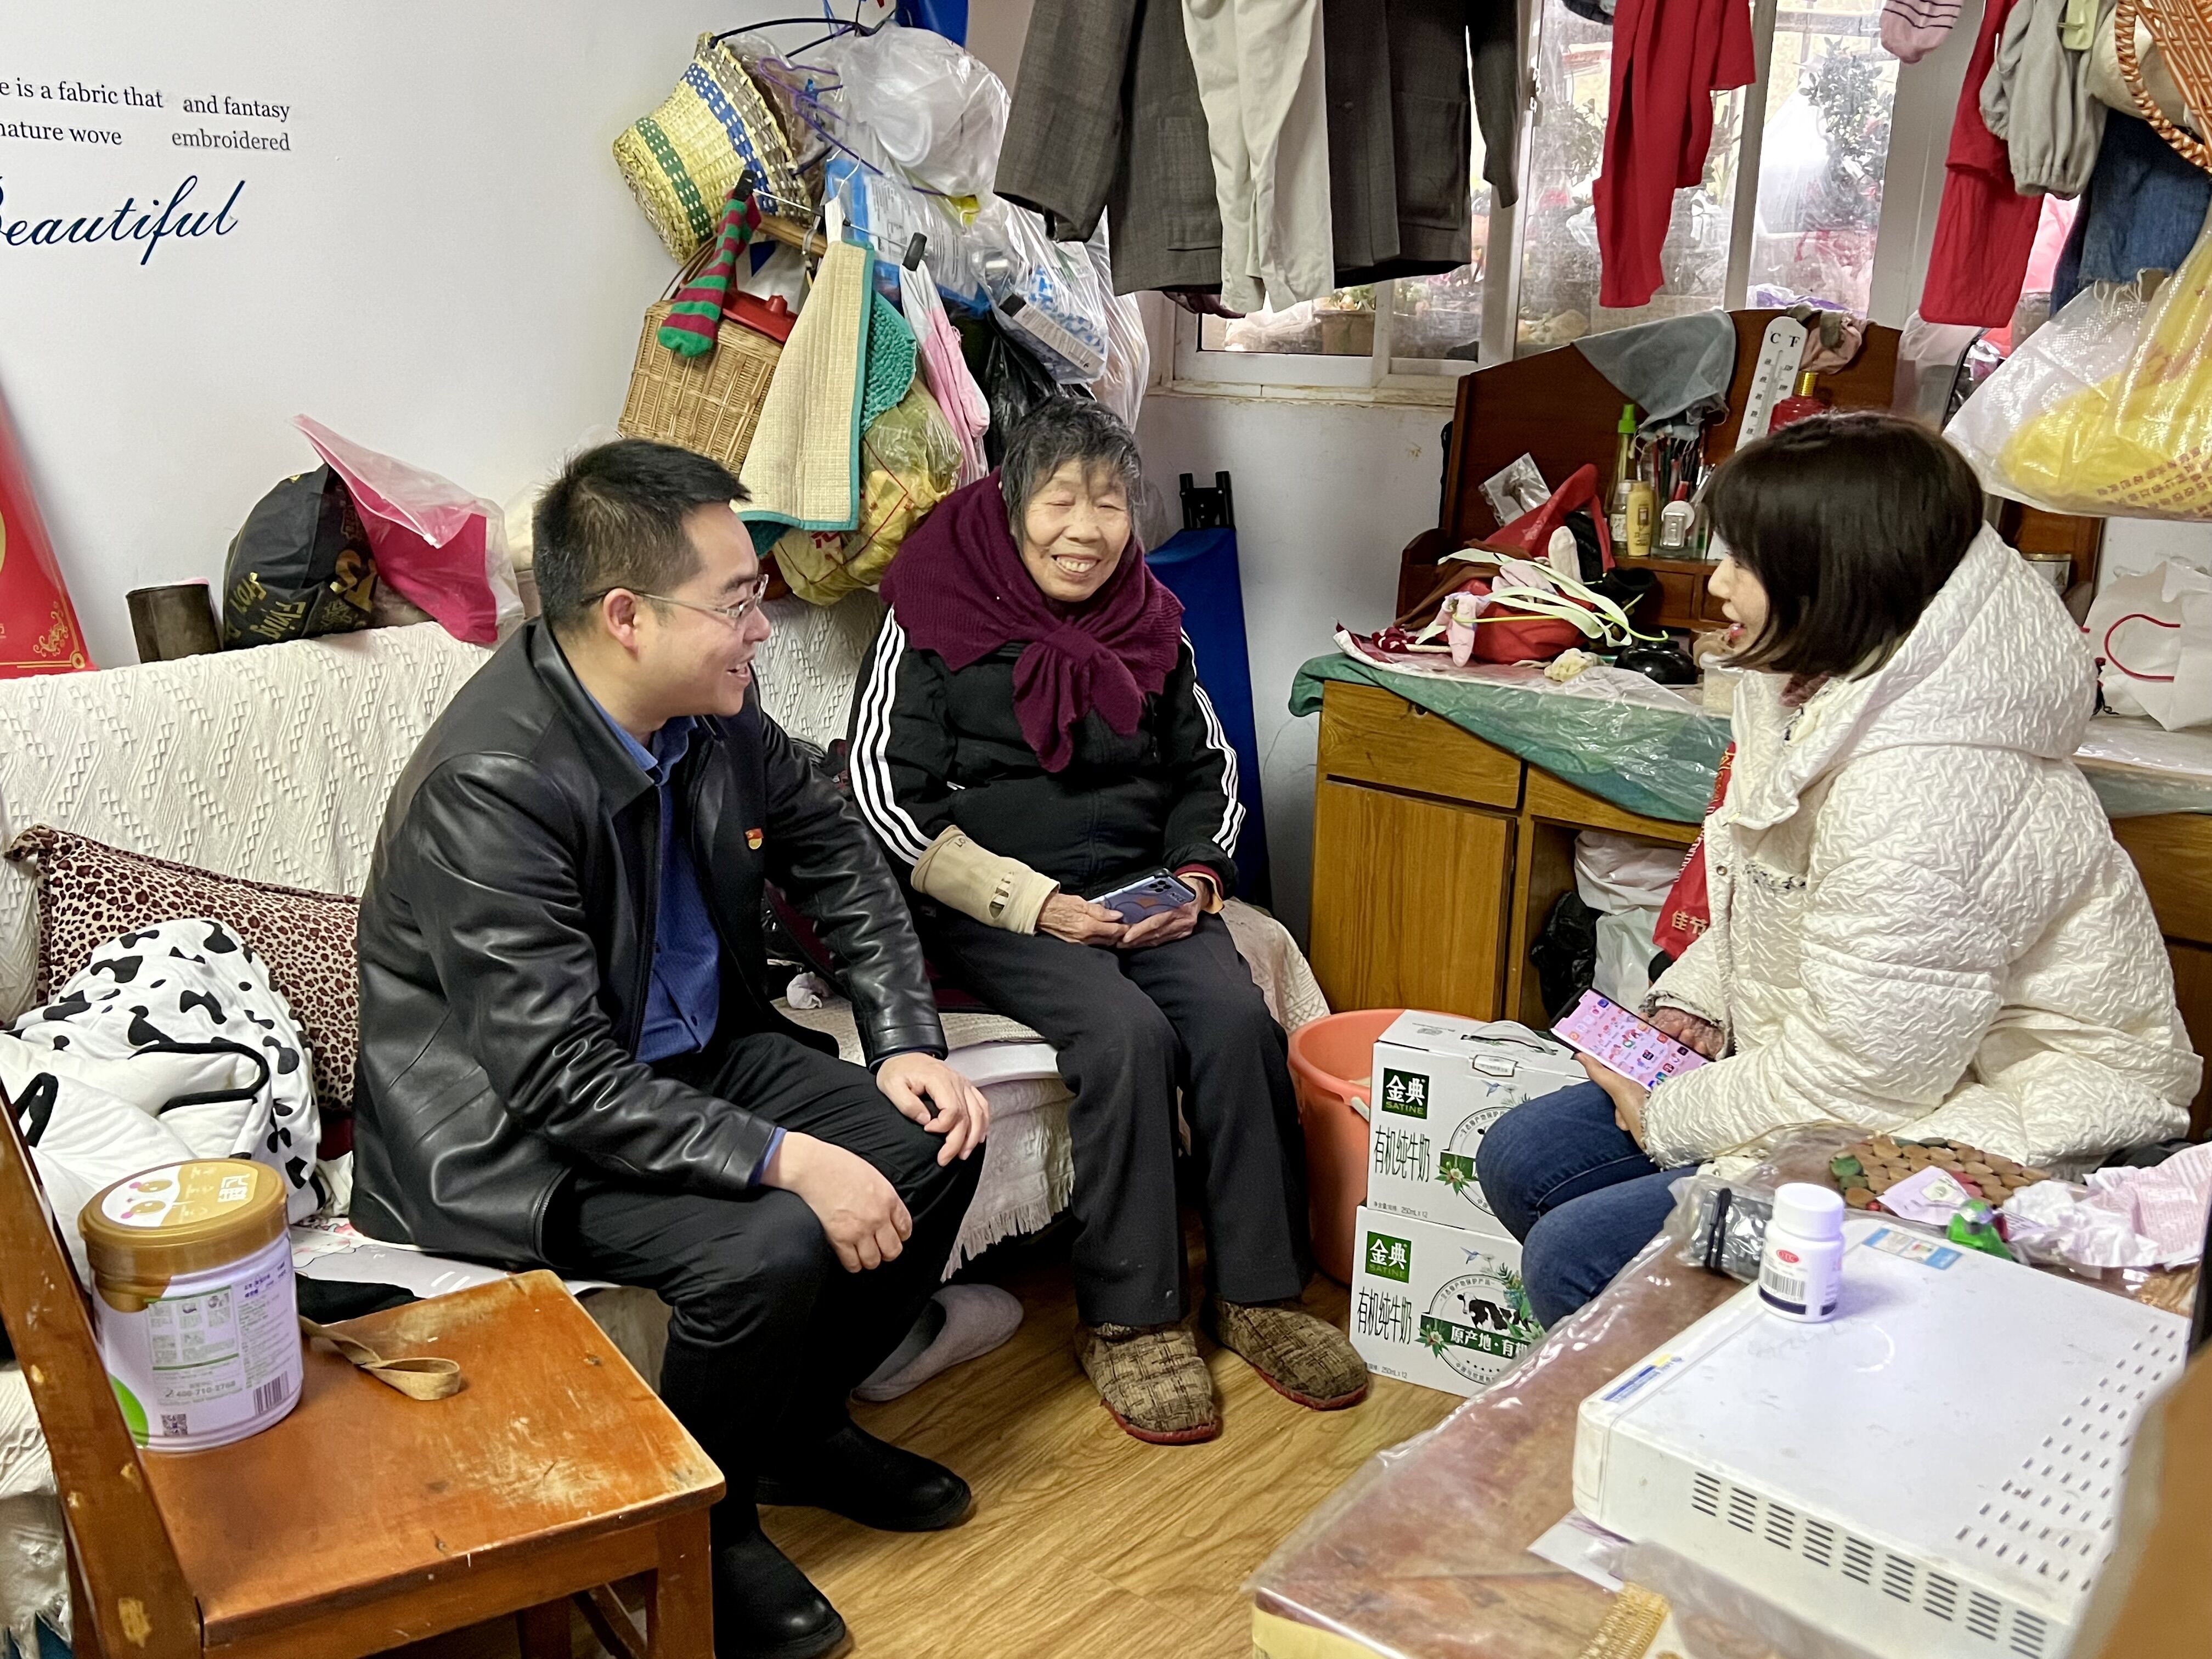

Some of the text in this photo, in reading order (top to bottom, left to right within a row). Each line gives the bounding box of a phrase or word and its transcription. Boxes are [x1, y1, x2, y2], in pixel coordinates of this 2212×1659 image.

[16, 77, 33, 97] is
[41, 85, 53, 99] a
[58, 81, 119, 104] fabric
[124, 86, 163, 108] that
[183, 95, 290, 122] and fantasy
[69, 127, 122, 145] wove
[172, 128, 291, 151] embroidered
[0, 175, 246, 266] eautiful
[1386, 1074, 1425, 1106] 金典
[1385, 1101, 1424, 1115] SATINE
[1374, 1125, 1430, 1182] 有机纯牛奶
[1369, 1238, 1407, 1270] 金典
[1369, 1263, 1406, 1279] SATINE
[1357, 1286, 1412, 1345] 有机纯牛奶
